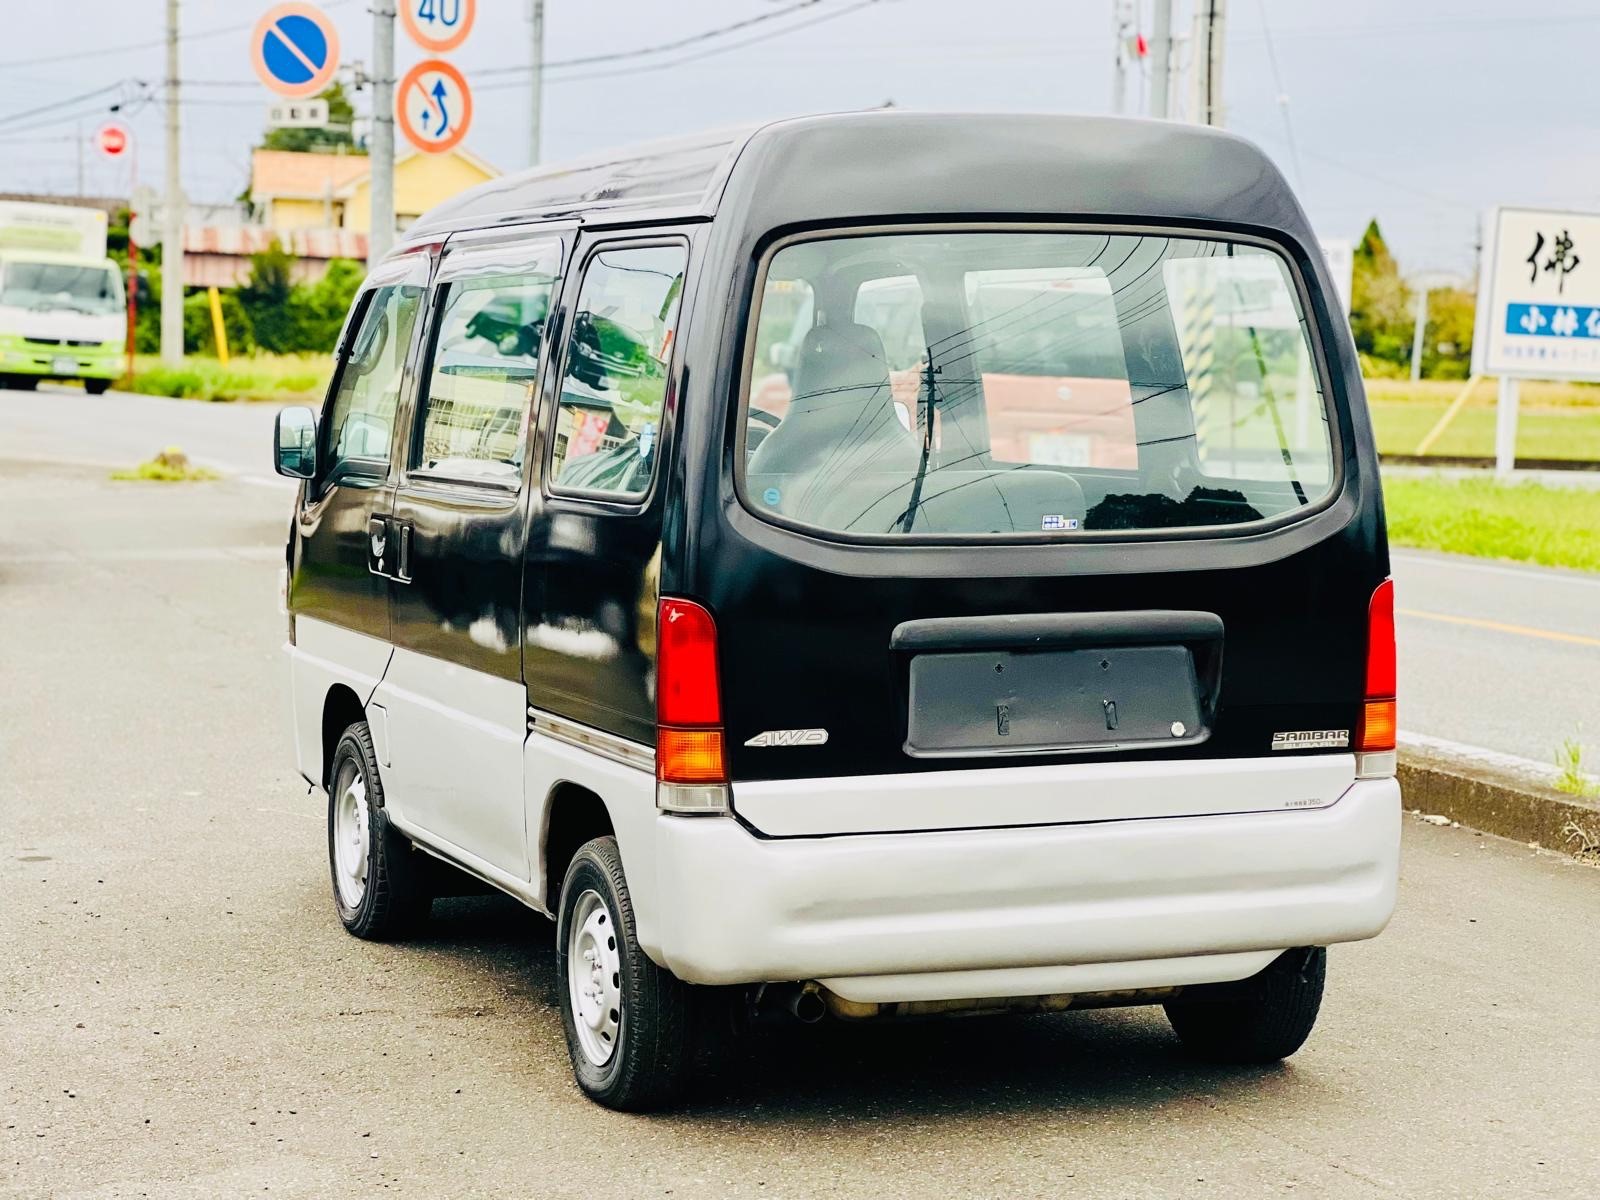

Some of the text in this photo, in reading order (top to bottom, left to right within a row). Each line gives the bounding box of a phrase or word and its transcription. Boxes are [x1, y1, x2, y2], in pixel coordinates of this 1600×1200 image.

[419, 0, 459, 26] 40
[1526, 230, 1580, 294] 佛
[744, 728, 829, 747] 4WD
[1273, 730, 1348, 742] SAMBAR
